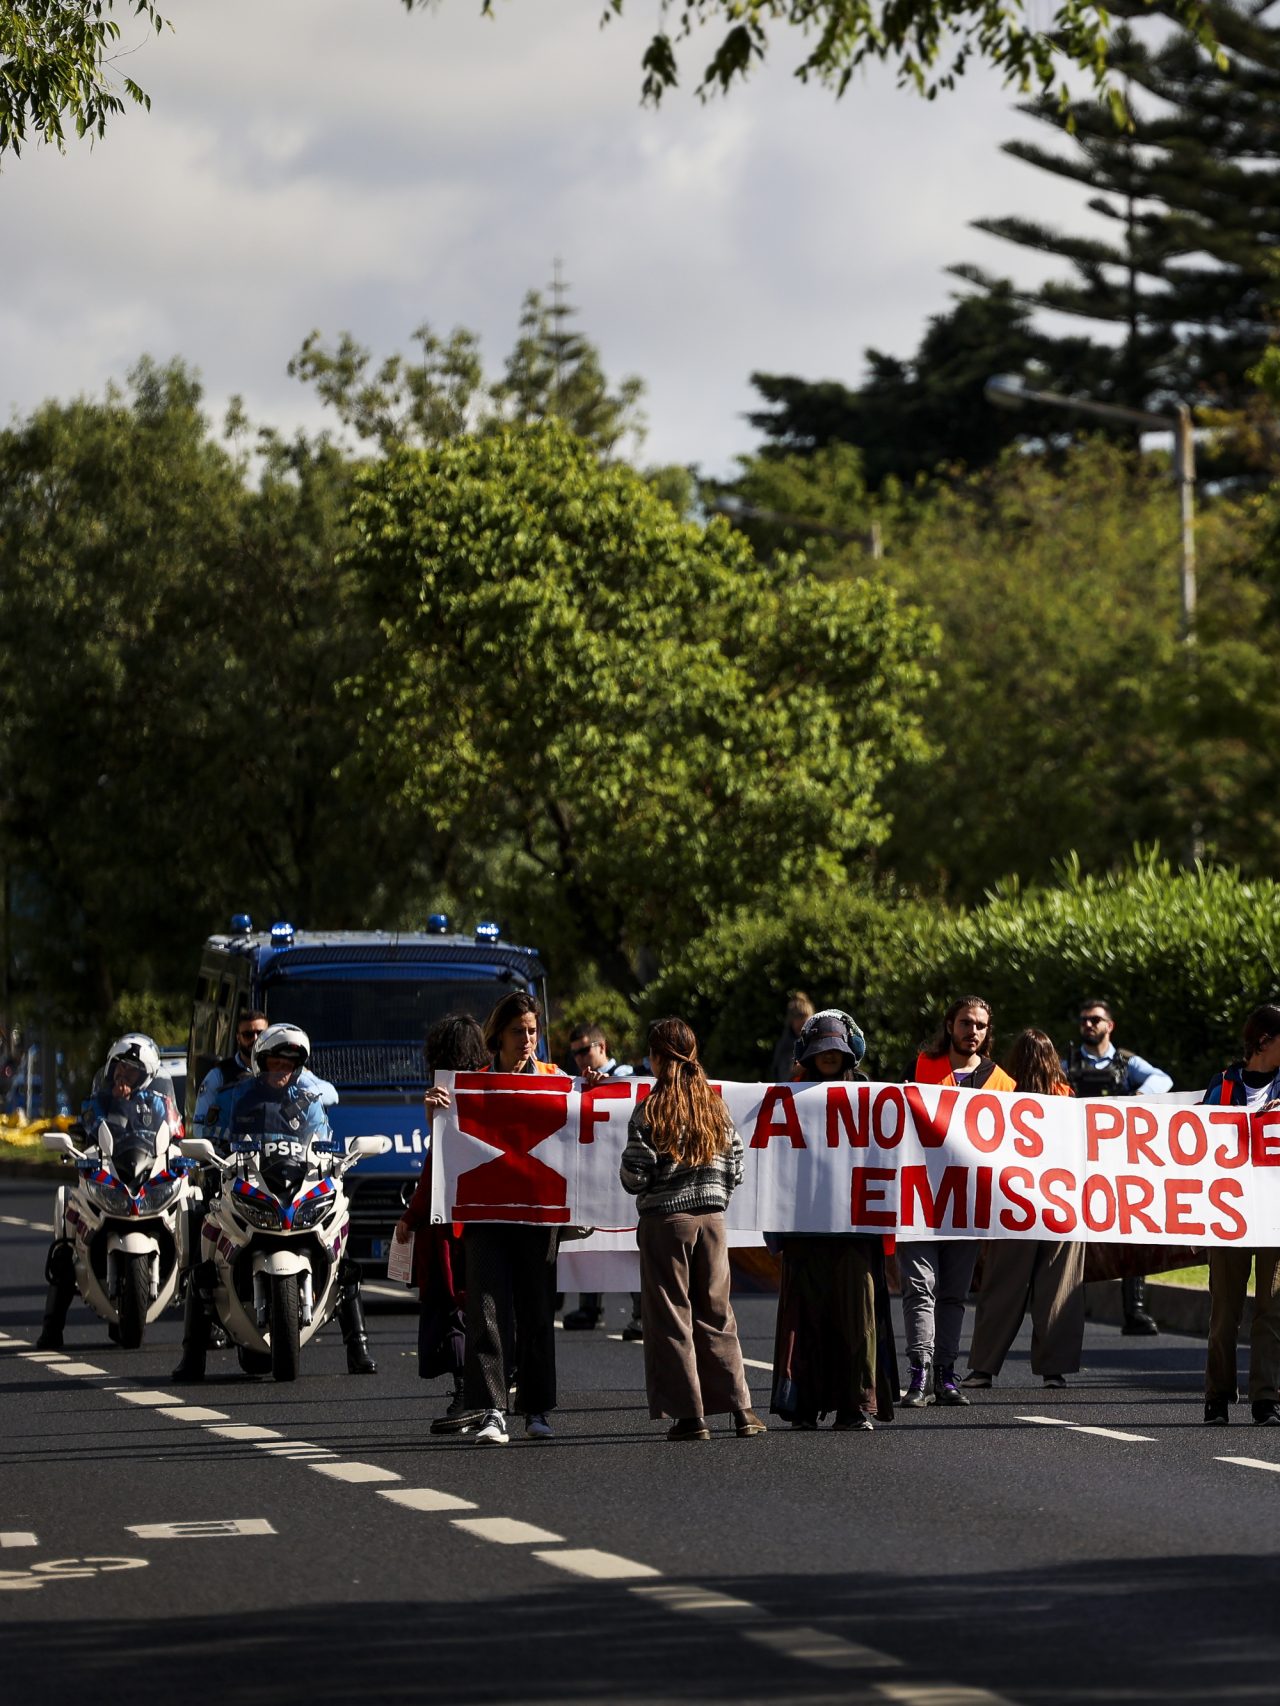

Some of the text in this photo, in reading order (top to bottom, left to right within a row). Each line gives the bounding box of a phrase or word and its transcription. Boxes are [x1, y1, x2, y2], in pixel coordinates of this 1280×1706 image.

[264, 1141, 303, 1158] PSP
[749, 1085, 807, 1149] A
[826, 1085, 1045, 1158] NOVOS
[851, 1165, 1248, 1241] EMISSORES
